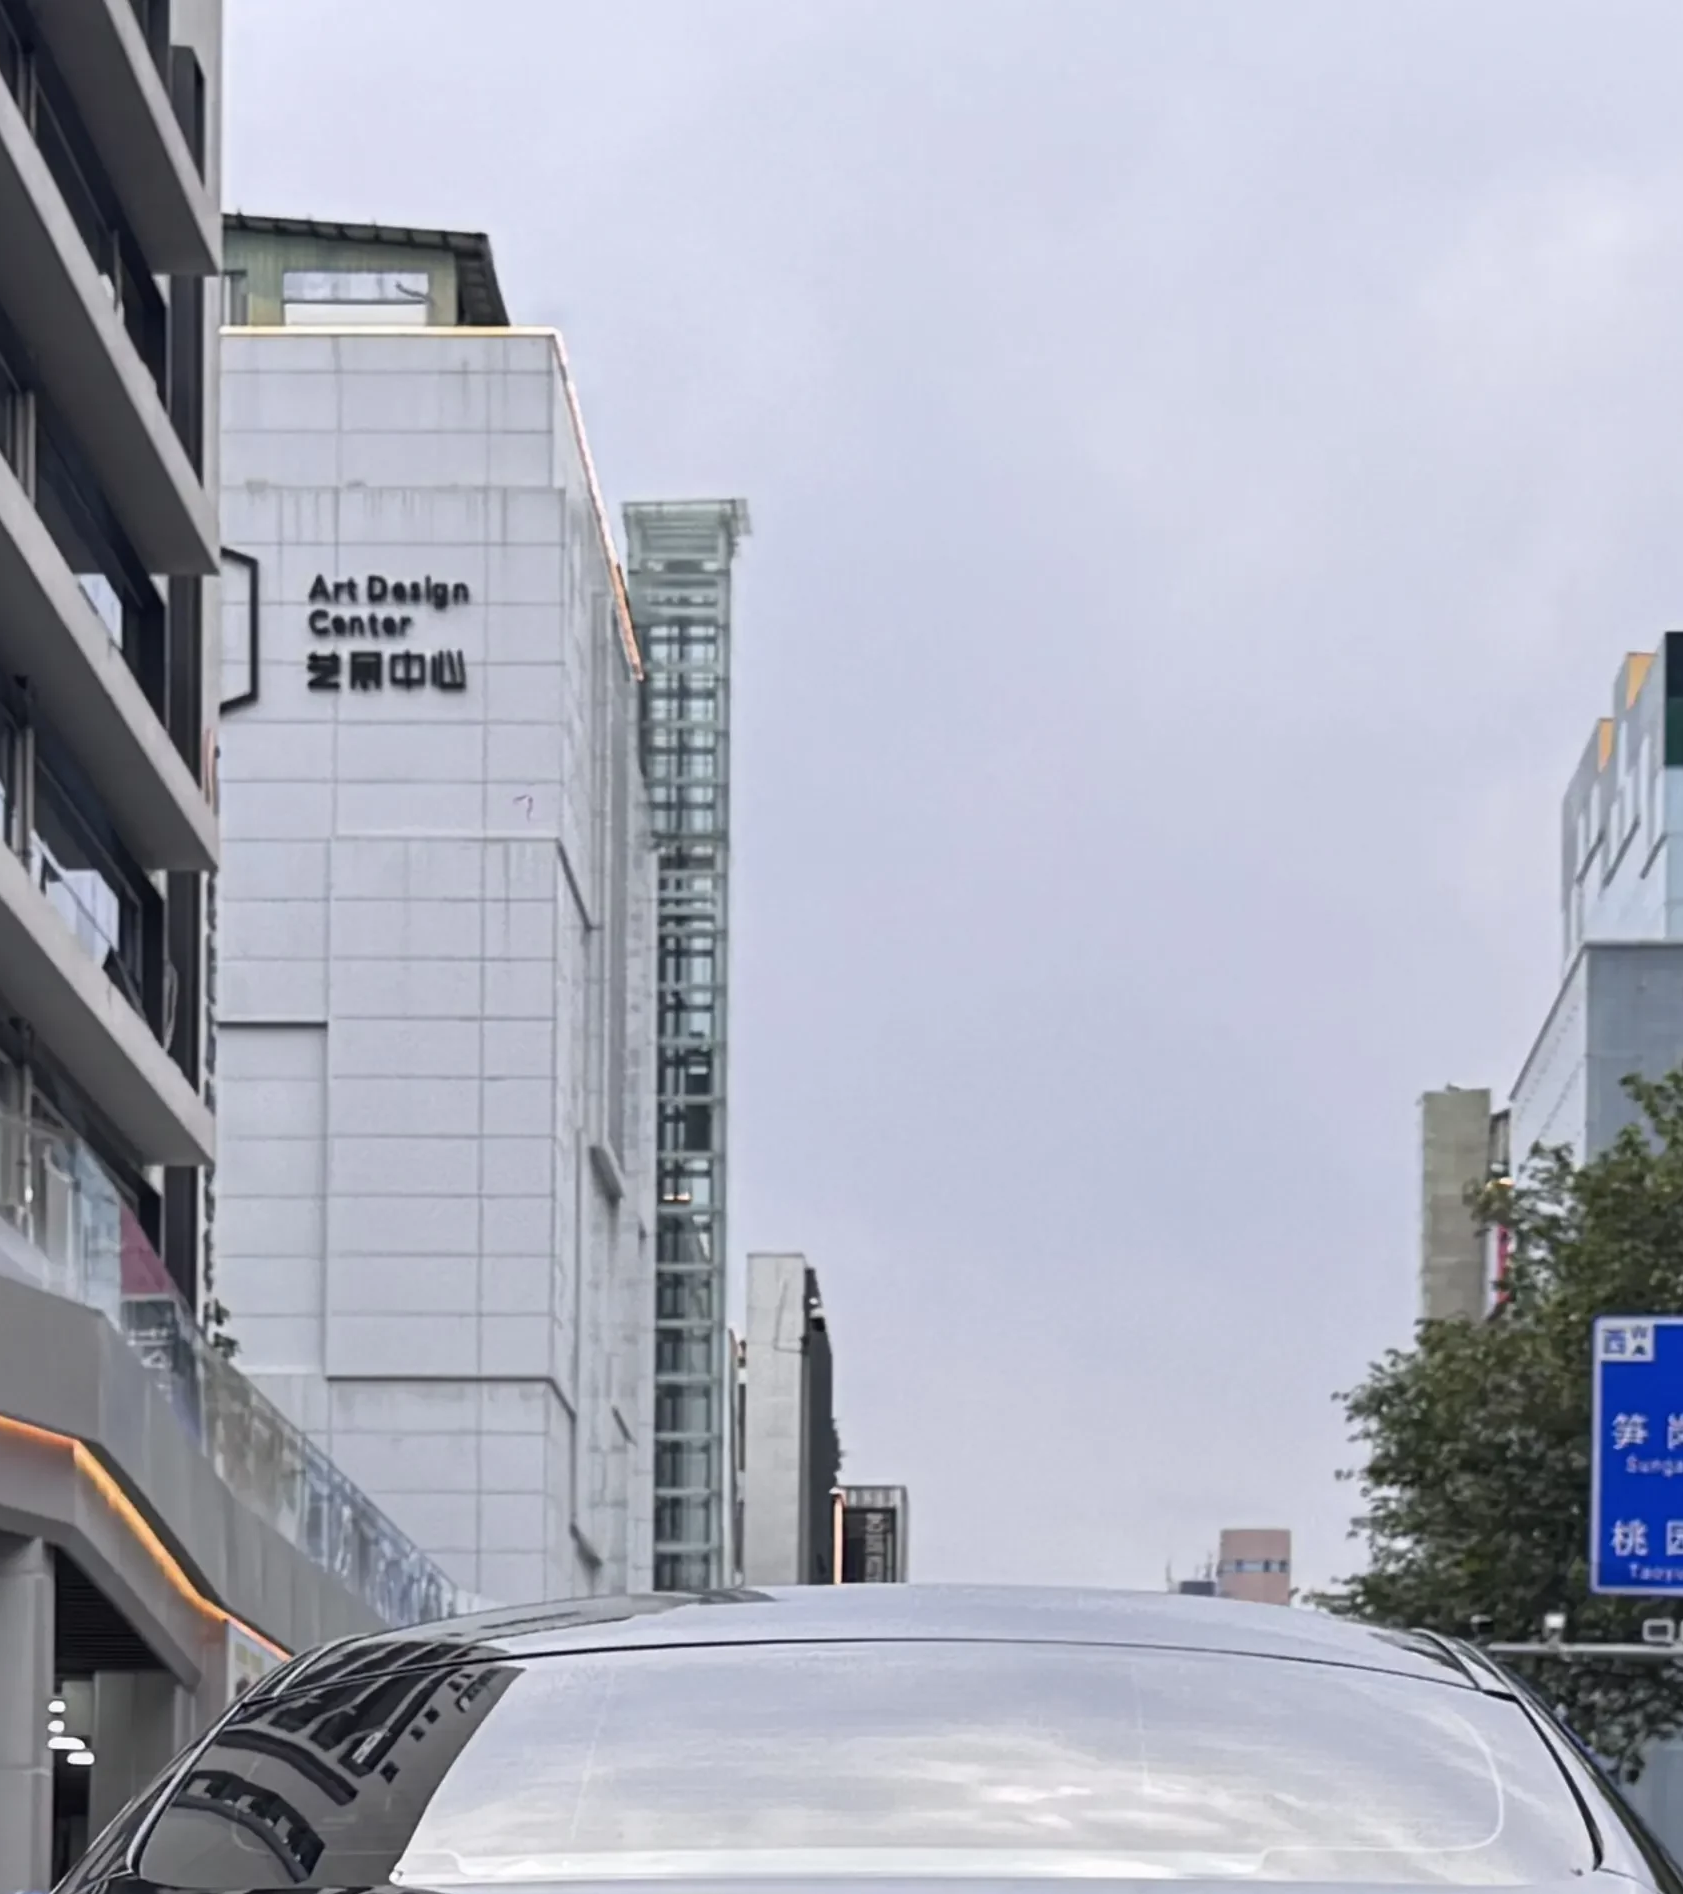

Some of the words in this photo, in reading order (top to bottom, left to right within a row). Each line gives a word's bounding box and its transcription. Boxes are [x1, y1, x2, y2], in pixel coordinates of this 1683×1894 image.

[309, 574, 358, 602] Art
[367, 574, 470, 609] Design
[308, 609, 412, 638] Center
[307, 650, 467, 691] 艺展中心
